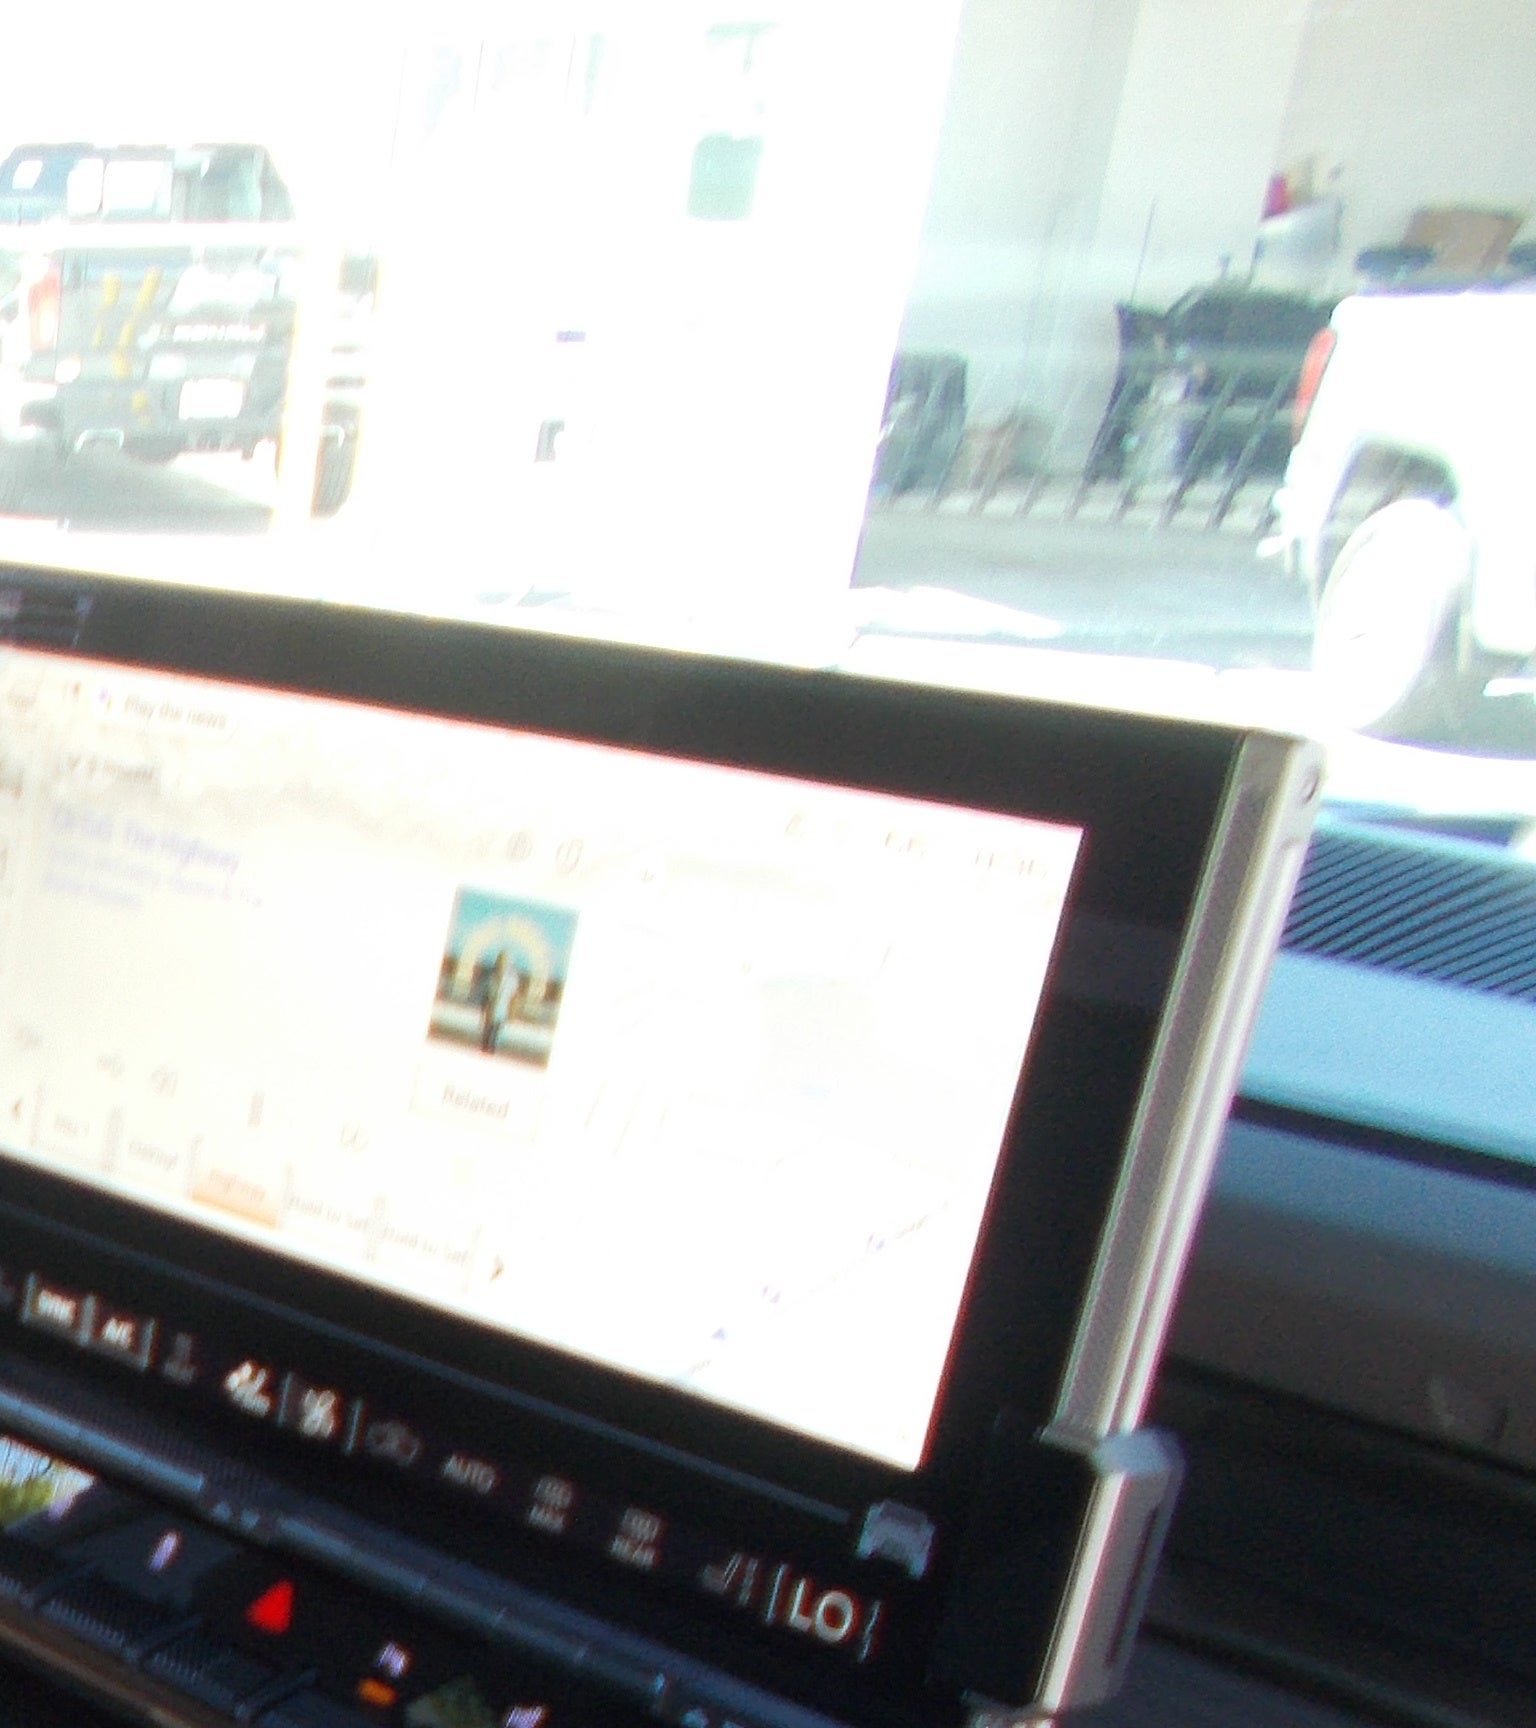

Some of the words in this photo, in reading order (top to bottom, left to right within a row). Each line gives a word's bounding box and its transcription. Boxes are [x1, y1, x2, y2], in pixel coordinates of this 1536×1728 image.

[159, 700, 183, 723] the
[442, 1082, 511, 1121] Related
[788, 1577, 855, 1642] LO
